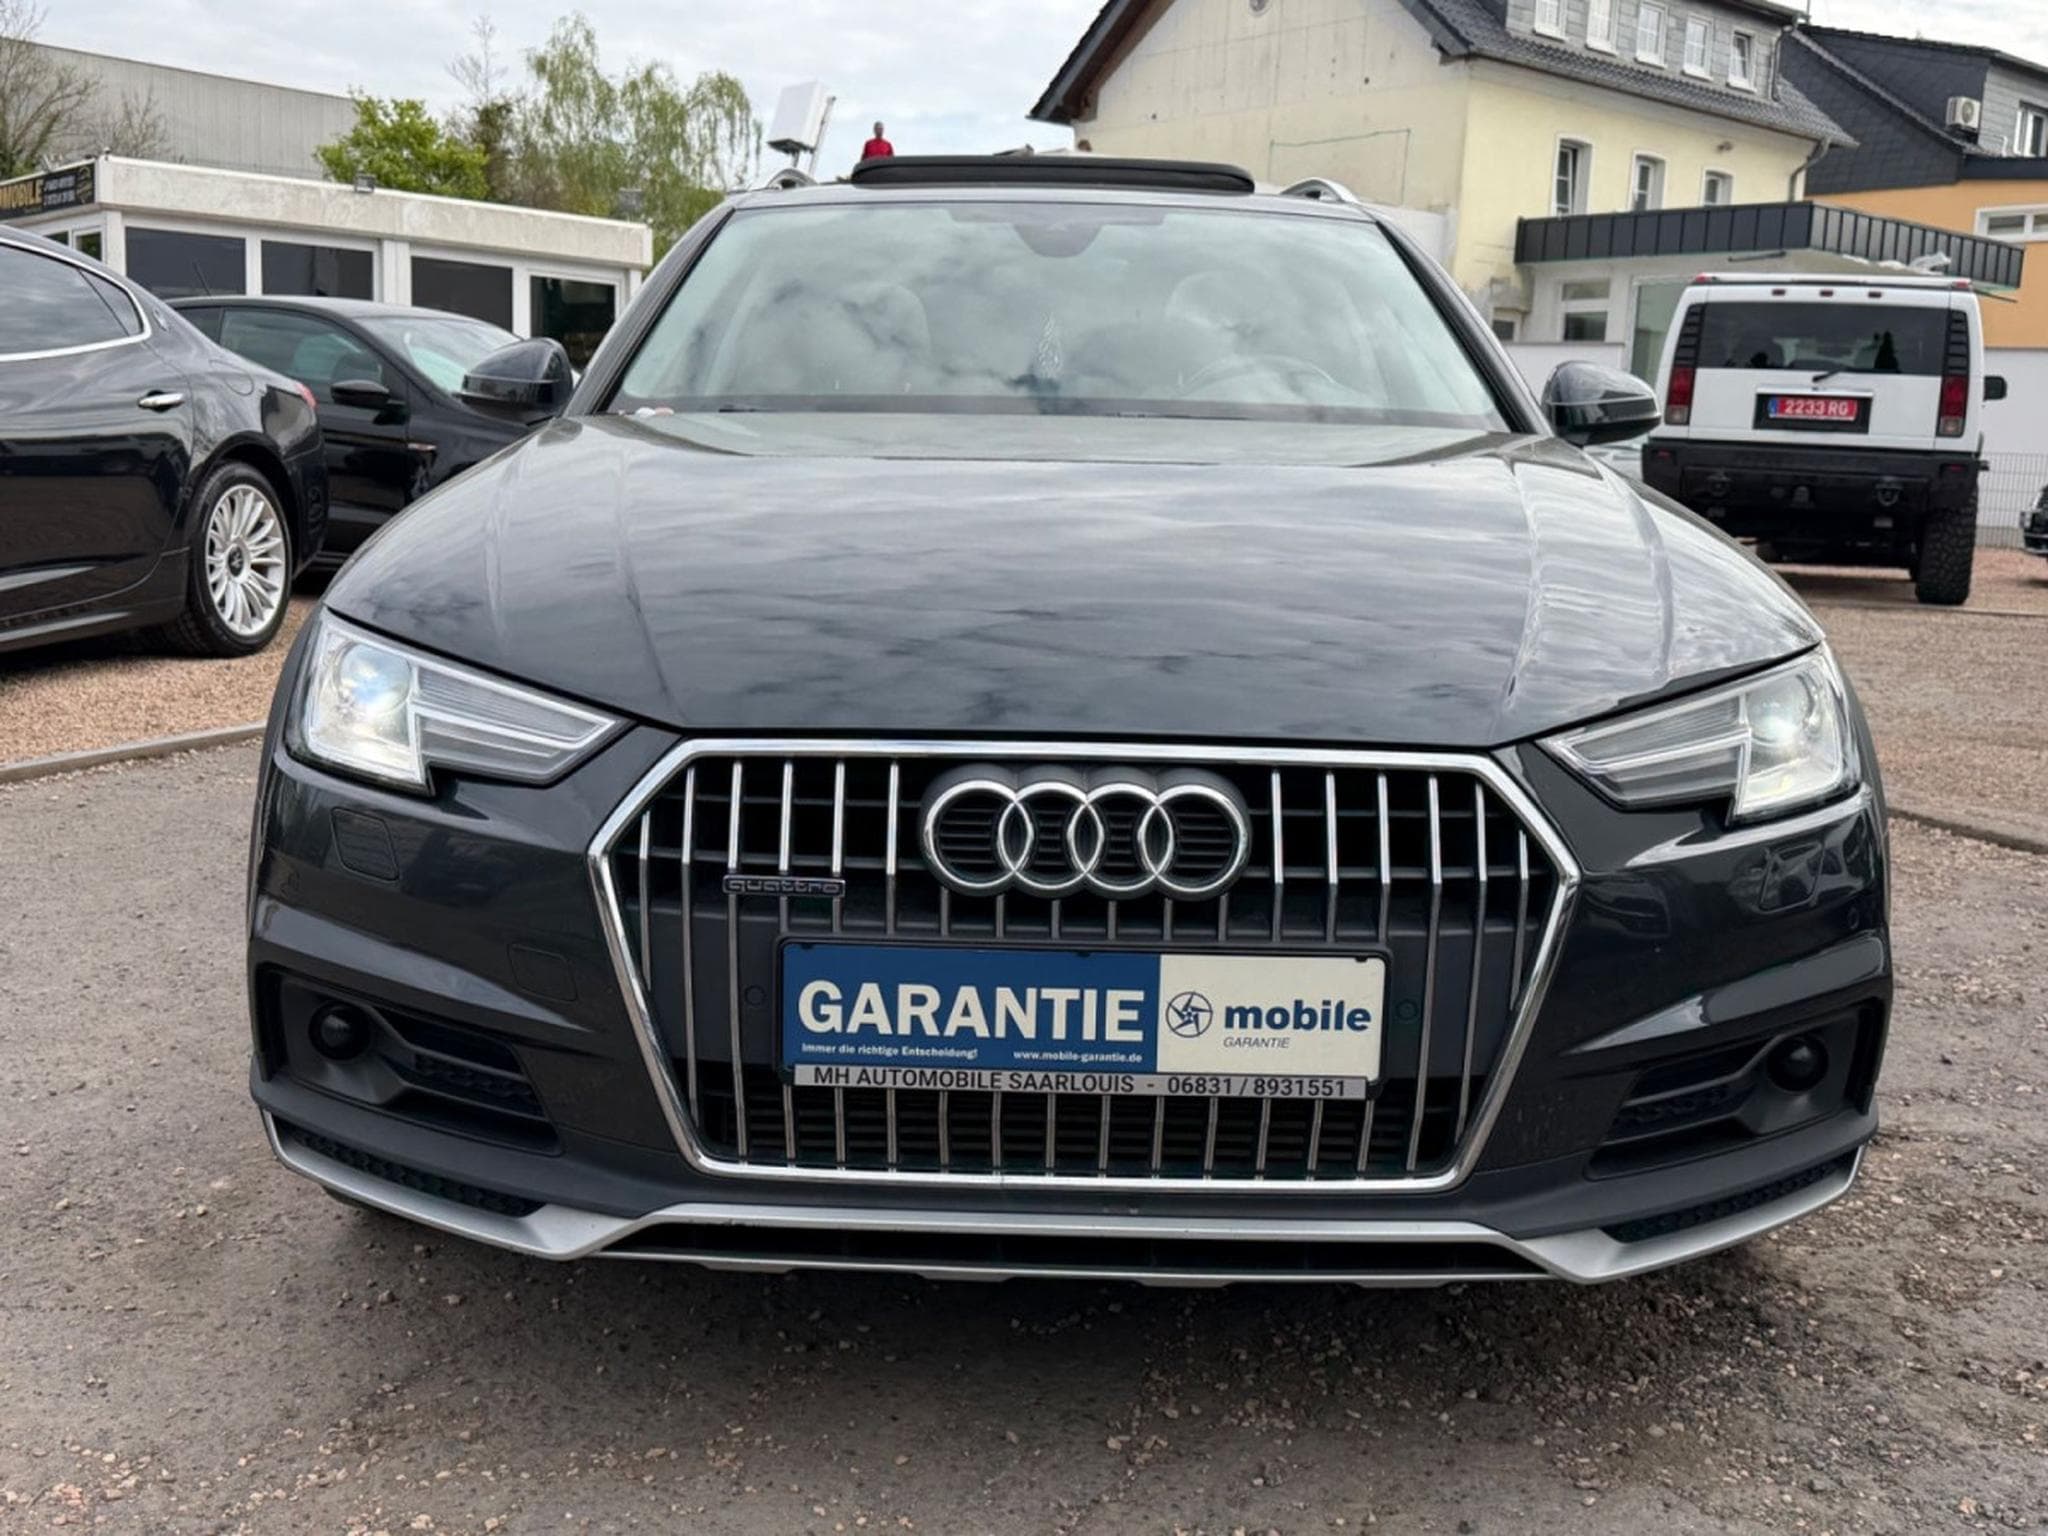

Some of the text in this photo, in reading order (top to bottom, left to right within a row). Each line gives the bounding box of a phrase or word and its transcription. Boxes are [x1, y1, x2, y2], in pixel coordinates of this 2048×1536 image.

[1785, 400, 1825, 415] 2233
[728, 880, 839, 893] quattro
[798, 979, 1145, 1042] GARANTIE
[1225, 1000, 1371, 1031] mobile
[1223, 1037, 1290, 1048] GARANTIE
[802, 1043, 978, 1060] Immer die richtige Entscheidung!
[1013, 1050, 1142, 1064] www.mobile-garantie.de
[814, 1067, 849, 1085] MH
[857, 1068, 1001, 1089] AUTOMOBILE
[1009, 1072, 1134, 1093] SAARLOUIS
